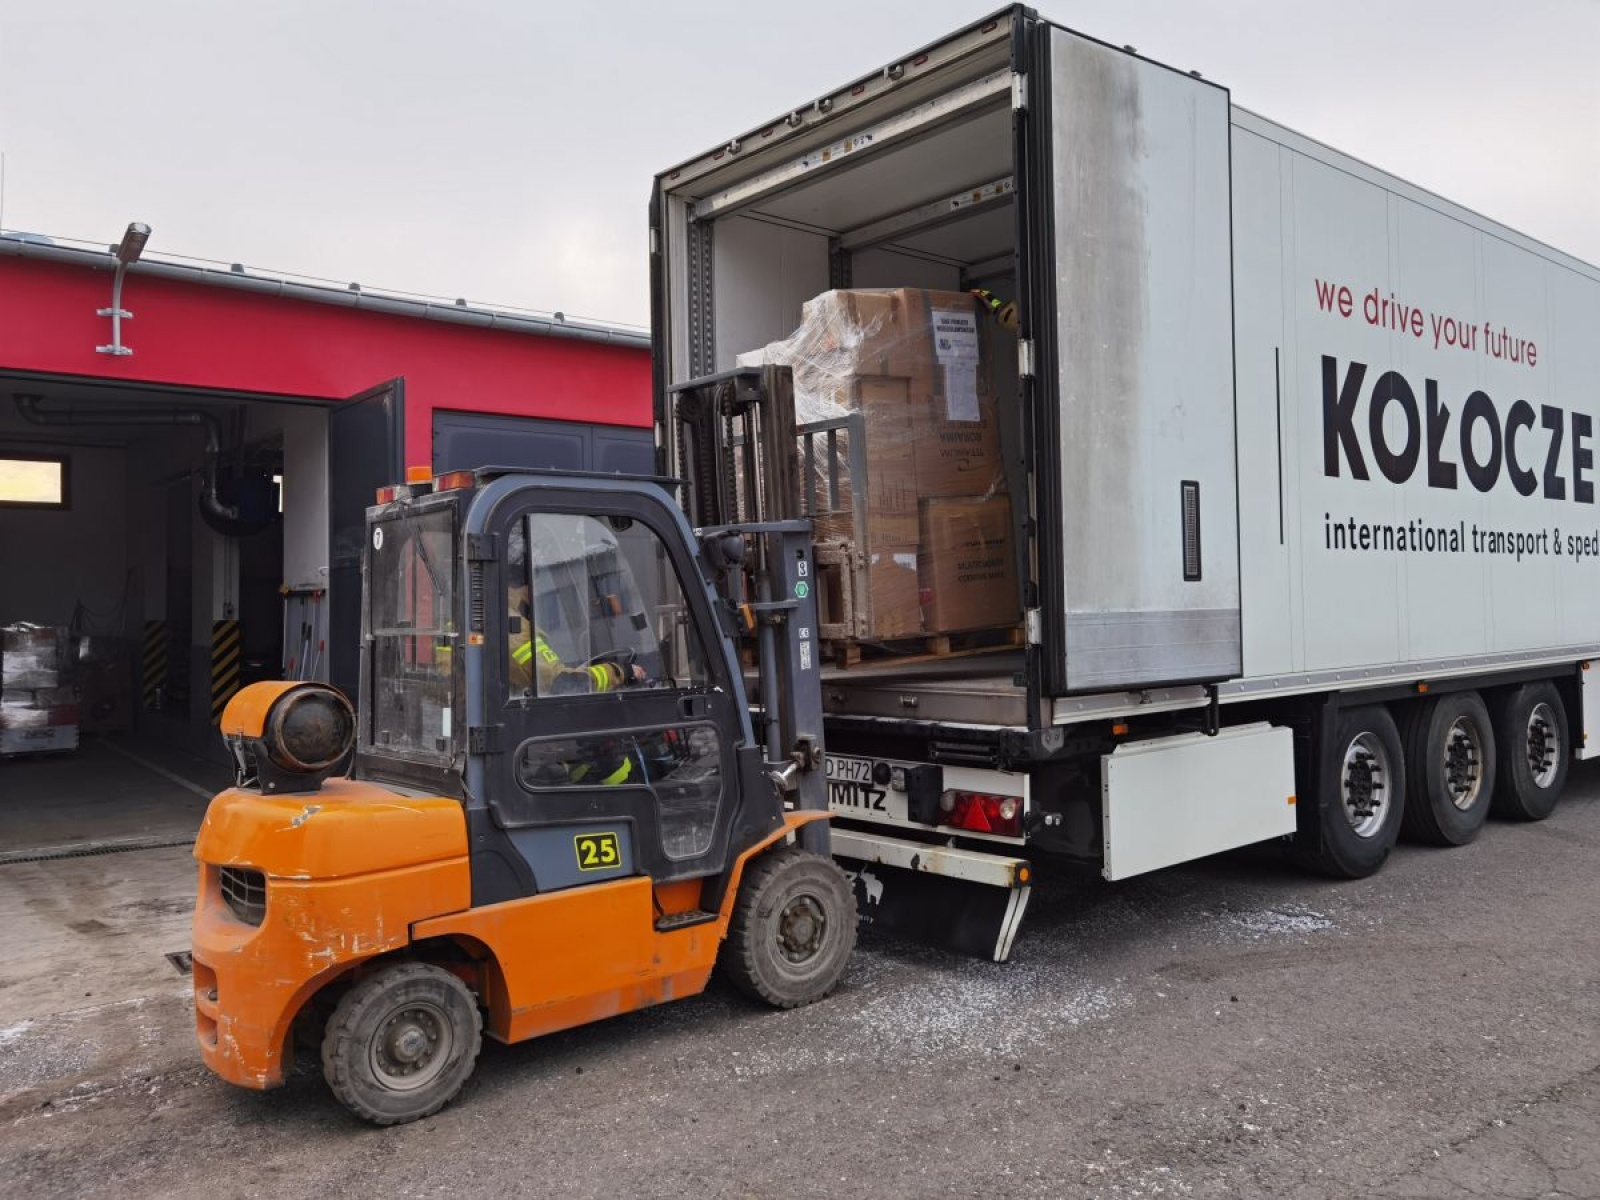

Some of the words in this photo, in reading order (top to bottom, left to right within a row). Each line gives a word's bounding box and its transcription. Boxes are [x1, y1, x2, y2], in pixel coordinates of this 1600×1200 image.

[1314, 278, 1353, 318] we
[1363, 287, 1424, 337] drive
[1430, 312, 1477, 351] your
[1483, 321, 1537, 367] future
[1321, 354, 1594, 504] KOŁOCZE
[1324, 512, 1465, 554] international
[1471, 523, 1549, 563] transport
[1553, 527, 1562, 555] &
[1567, 529, 1600, 563] sped
[837, 759, 870, 781] PH72
[828, 781, 886, 811] MITZ
[580, 838, 616, 865] 25
